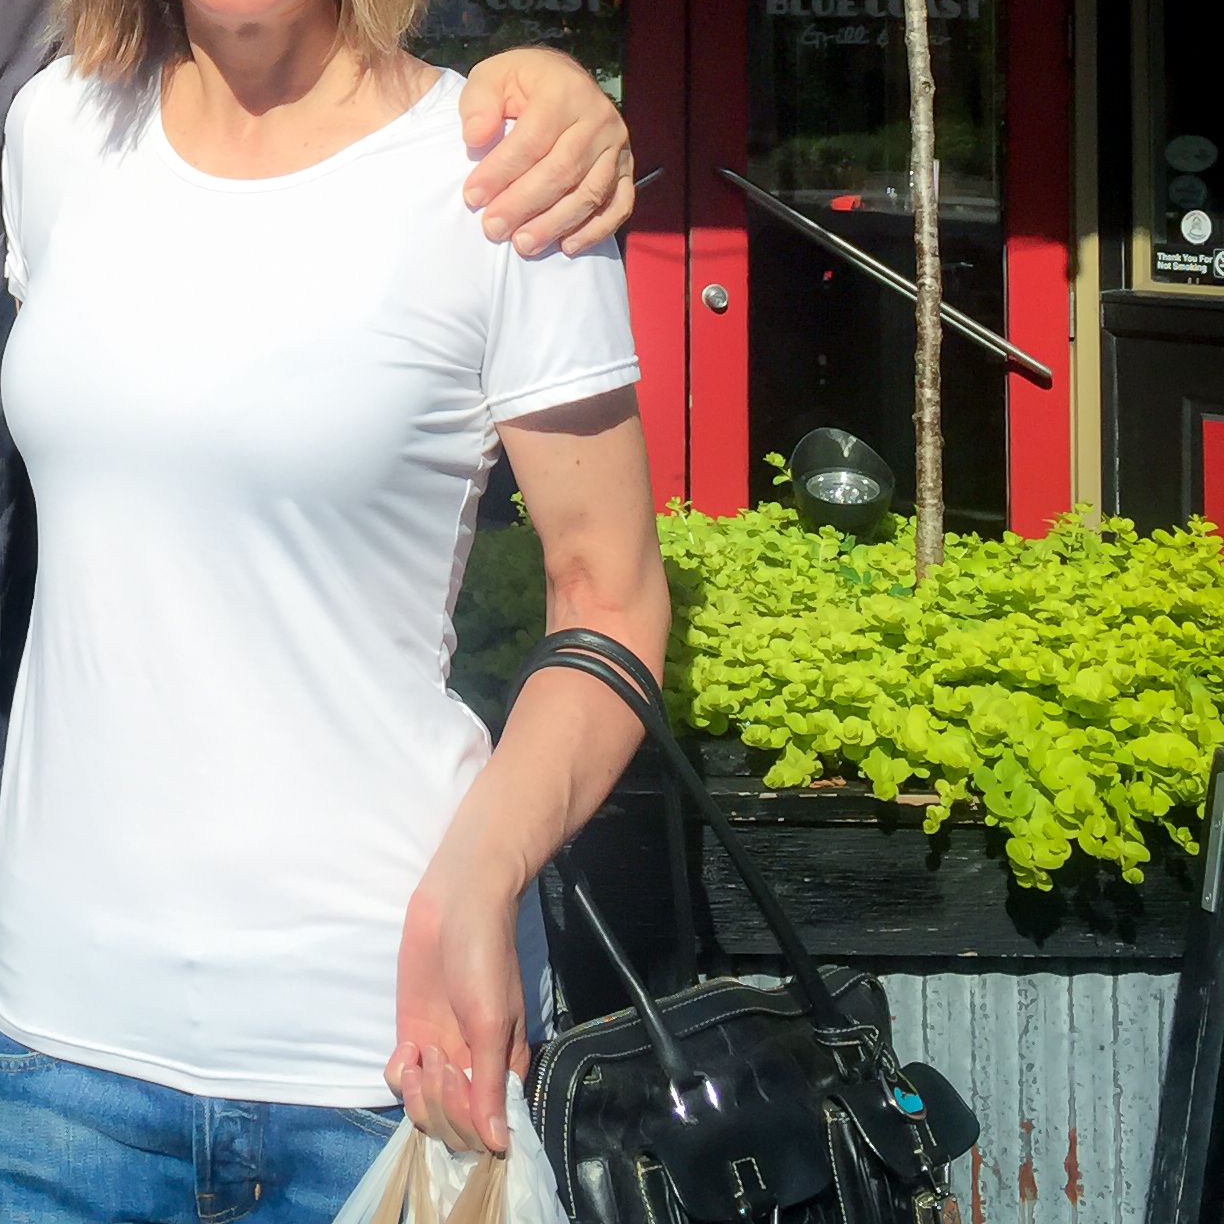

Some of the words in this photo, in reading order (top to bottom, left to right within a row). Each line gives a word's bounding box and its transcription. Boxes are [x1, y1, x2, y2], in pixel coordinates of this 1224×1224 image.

[800, 22, 870, 49] Grill
[1157, 252, 1181, 261] Thank
[1182, 253, 1197, 262] You
[1199, 254, 1213, 263] For
[1157, 260, 1172, 270] Not
[1172, 262, 1208, 274] Smoking
